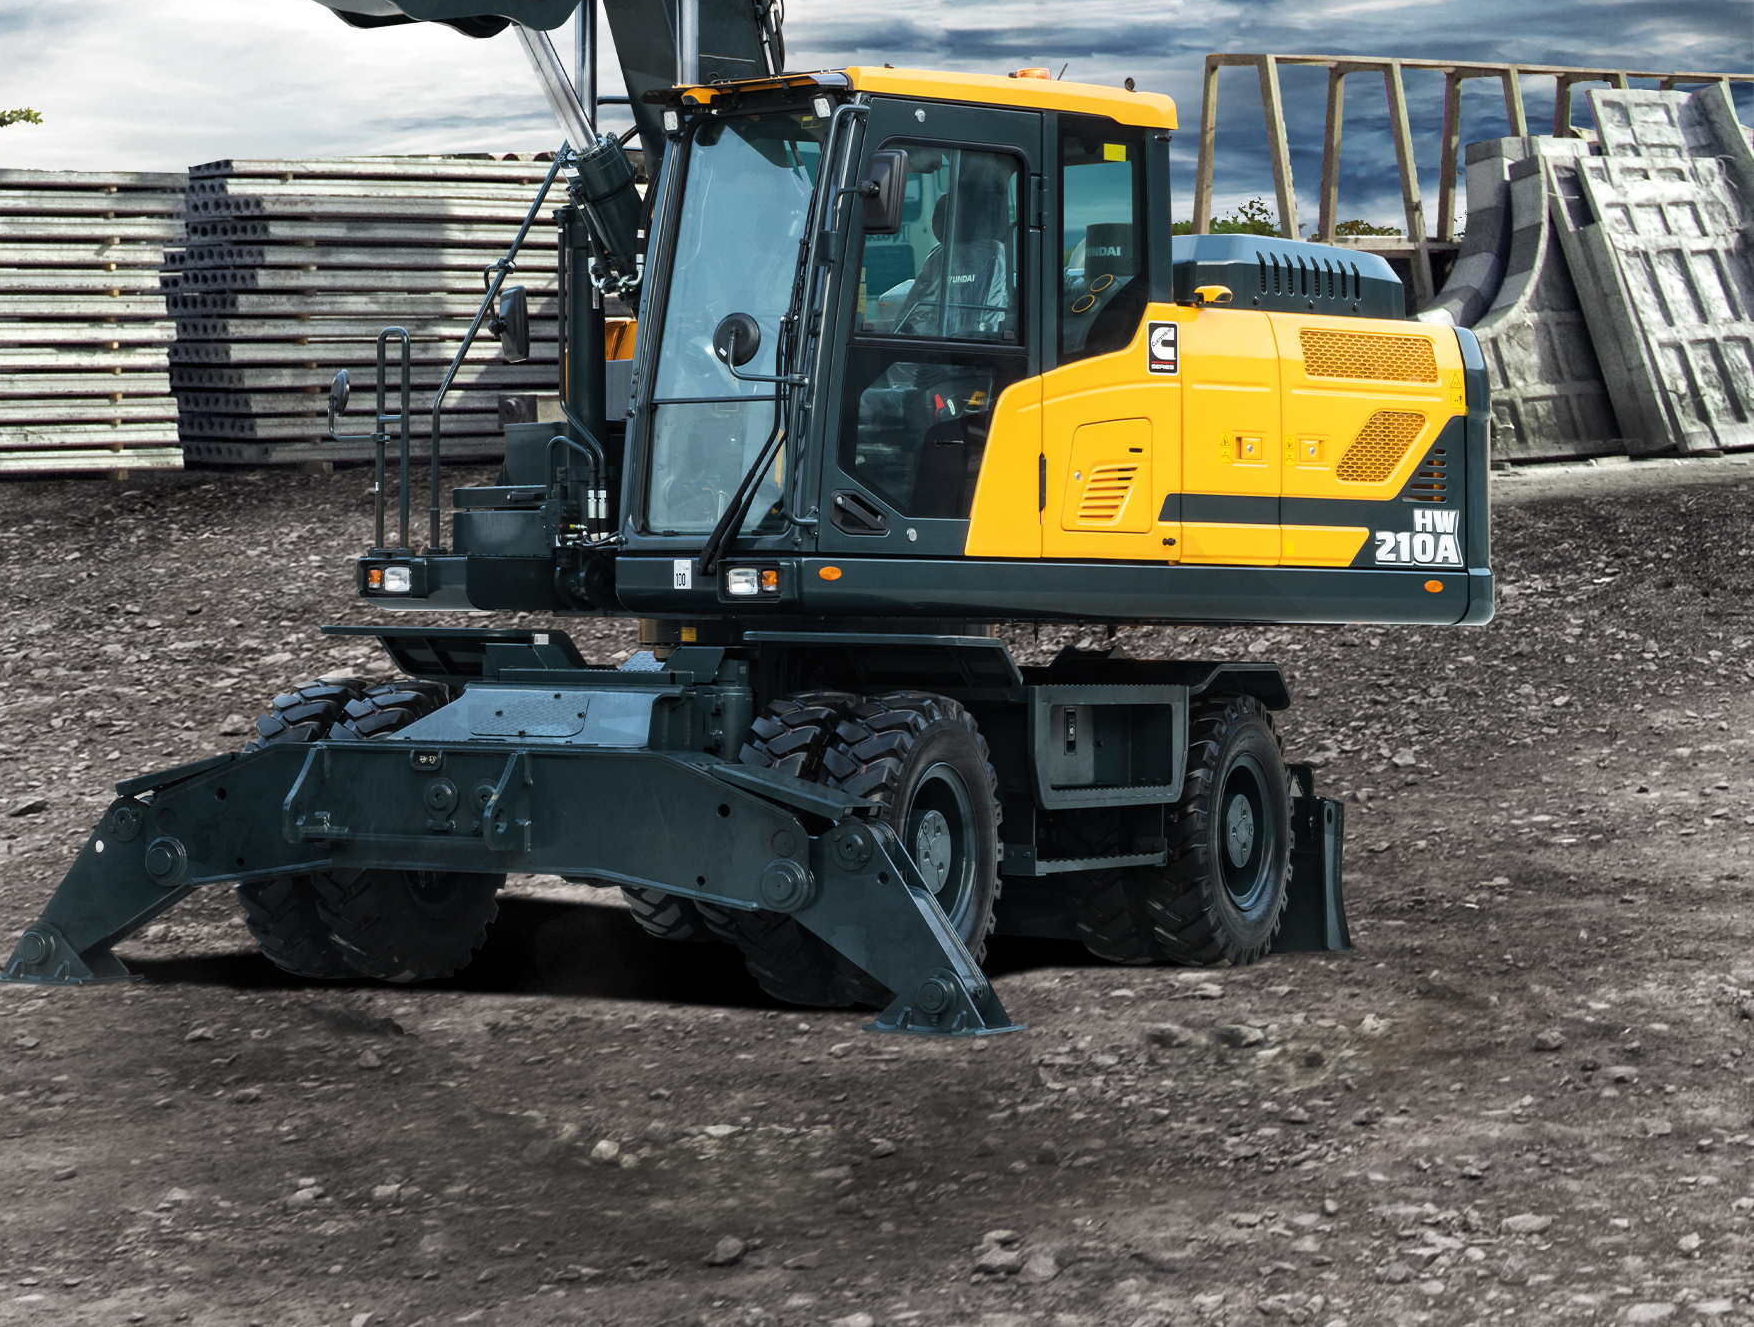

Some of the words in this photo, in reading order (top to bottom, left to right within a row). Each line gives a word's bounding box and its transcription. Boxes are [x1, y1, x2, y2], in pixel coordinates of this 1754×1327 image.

[949, 274, 975, 283] YUNDAI
[1413, 509, 1457, 533] HW
[1374, 531, 1460, 564] 210A
